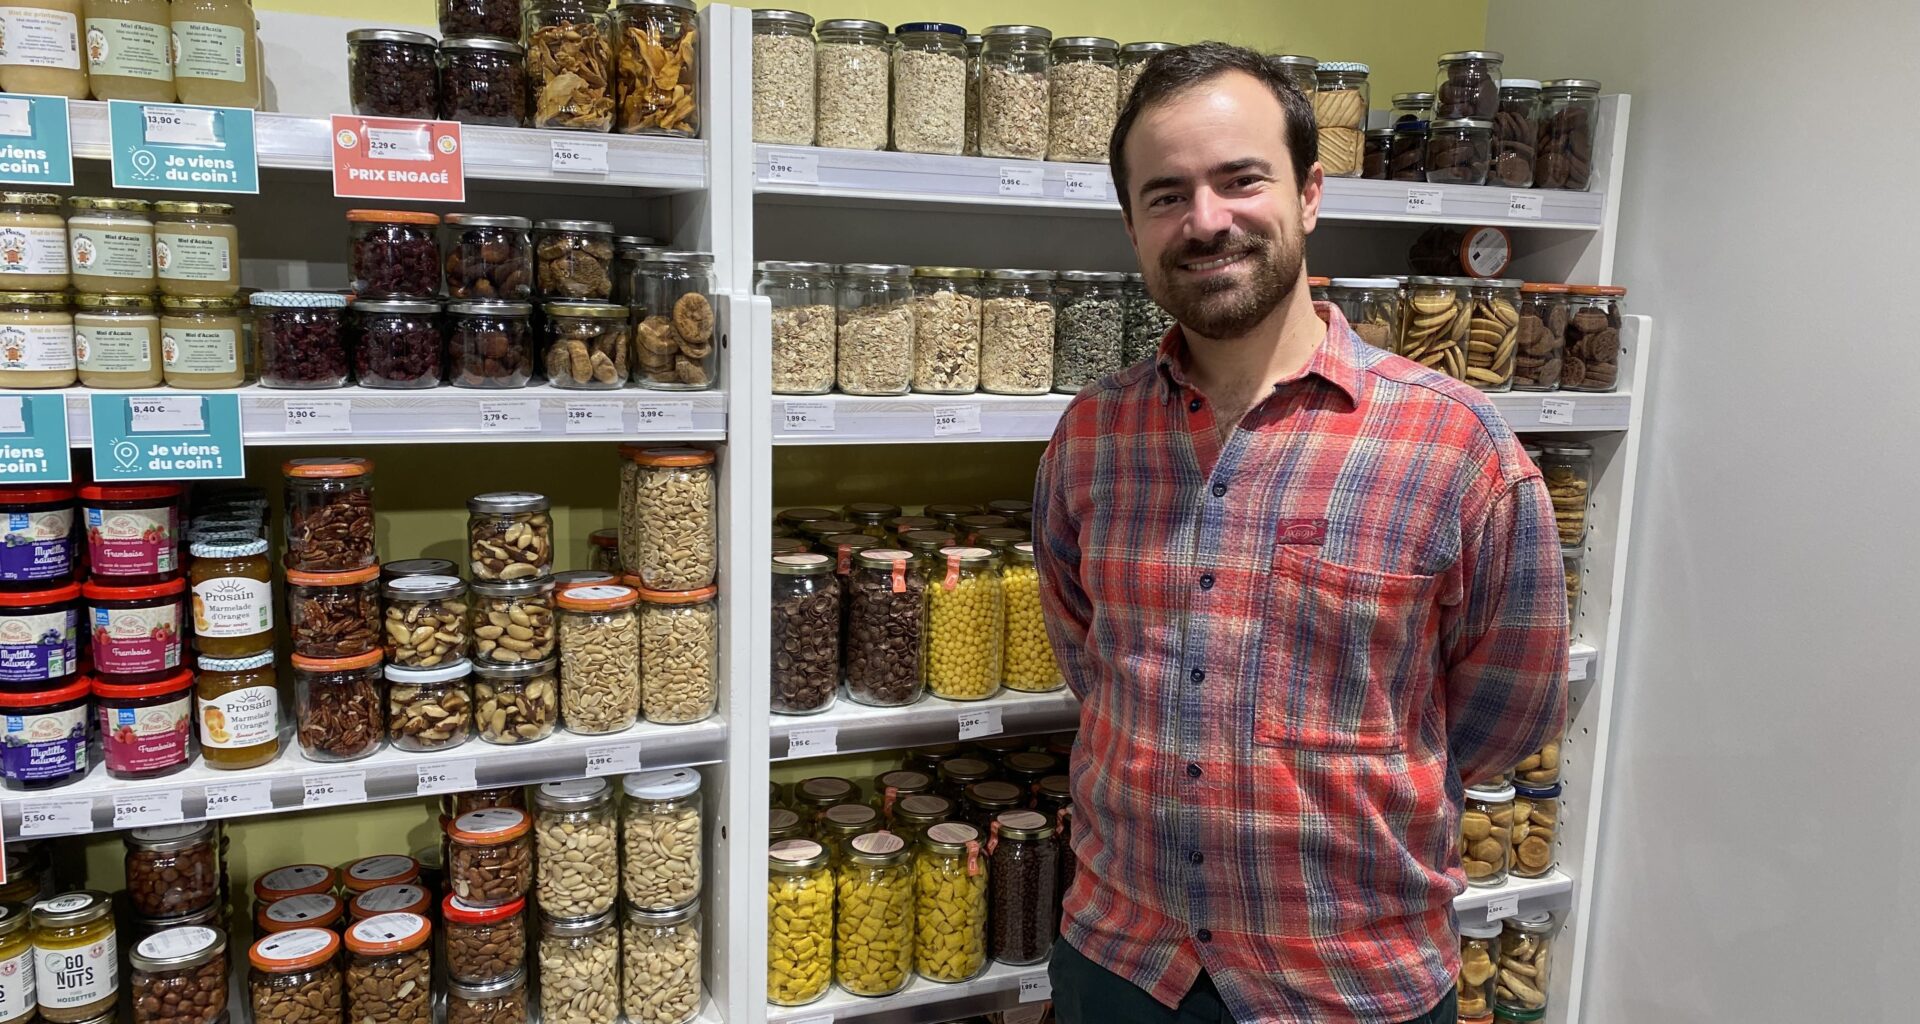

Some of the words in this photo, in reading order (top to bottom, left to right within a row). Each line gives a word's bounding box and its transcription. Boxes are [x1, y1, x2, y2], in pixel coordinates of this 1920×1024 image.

[148, 115, 171, 124] 13,90
[371, 141, 389, 149] 2,29
[0, 144, 47, 160] viens
[554, 151, 572, 159] 4,50
[164, 154, 185, 167] Je
[187, 154, 234, 169] viens
[0, 159, 40, 174] coin
[43, 161, 50, 174] !
[165, 167, 189, 181] du
[191, 168, 228, 182] coin
[231, 170, 237, 183] !
[349, 168, 386, 181] PRIX
[387, 168, 449, 184] ENGAGÉ
[133, 405, 156, 414] 8,40
[640, 410, 656, 418] 3,99
[288, 411, 307, 419] 3,90
[483, 413, 500, 421] 3,79
[568, 411, 585, 419] 3,99
[147, 444, 169, 456] Je
[171, 442, 220, 456] viens
[0, 459, 37, 473] coin
[41, 459, 48, 473] !
[148, 457, 173, 470] du
[175, 456, 213, 470] coin
[216, 456, 222, 469] !
[104, 549, 145, 558] Framboise
[205, 590, 254, 602] Prosain
[209, 603, 252, 612] Marmelade
[211, 613, 250, 621] d'Oranges
[0, 649, 36, 662] Myrtille
[112, 647, 152, 657] Framboise
[1, 660, 37, 669] sauvage
[226, 698, 272, 713] Prosain
[231, 711, 270, 723] Marmelade
[234, 720, 269, 731] d'Oranges
[138, 742, 177, 753] Framboise
[420, 775, 438, 783] 6,95
[306, 787, 325, 796] 4,49
[208, 795, 229, 804] 4,45
[117, 806, 137, 814] 5,90
[24, 814, 46, 823] 5,50
[65, 954, 84, 970] GO
[56, 966, 94, 989] NUTS
